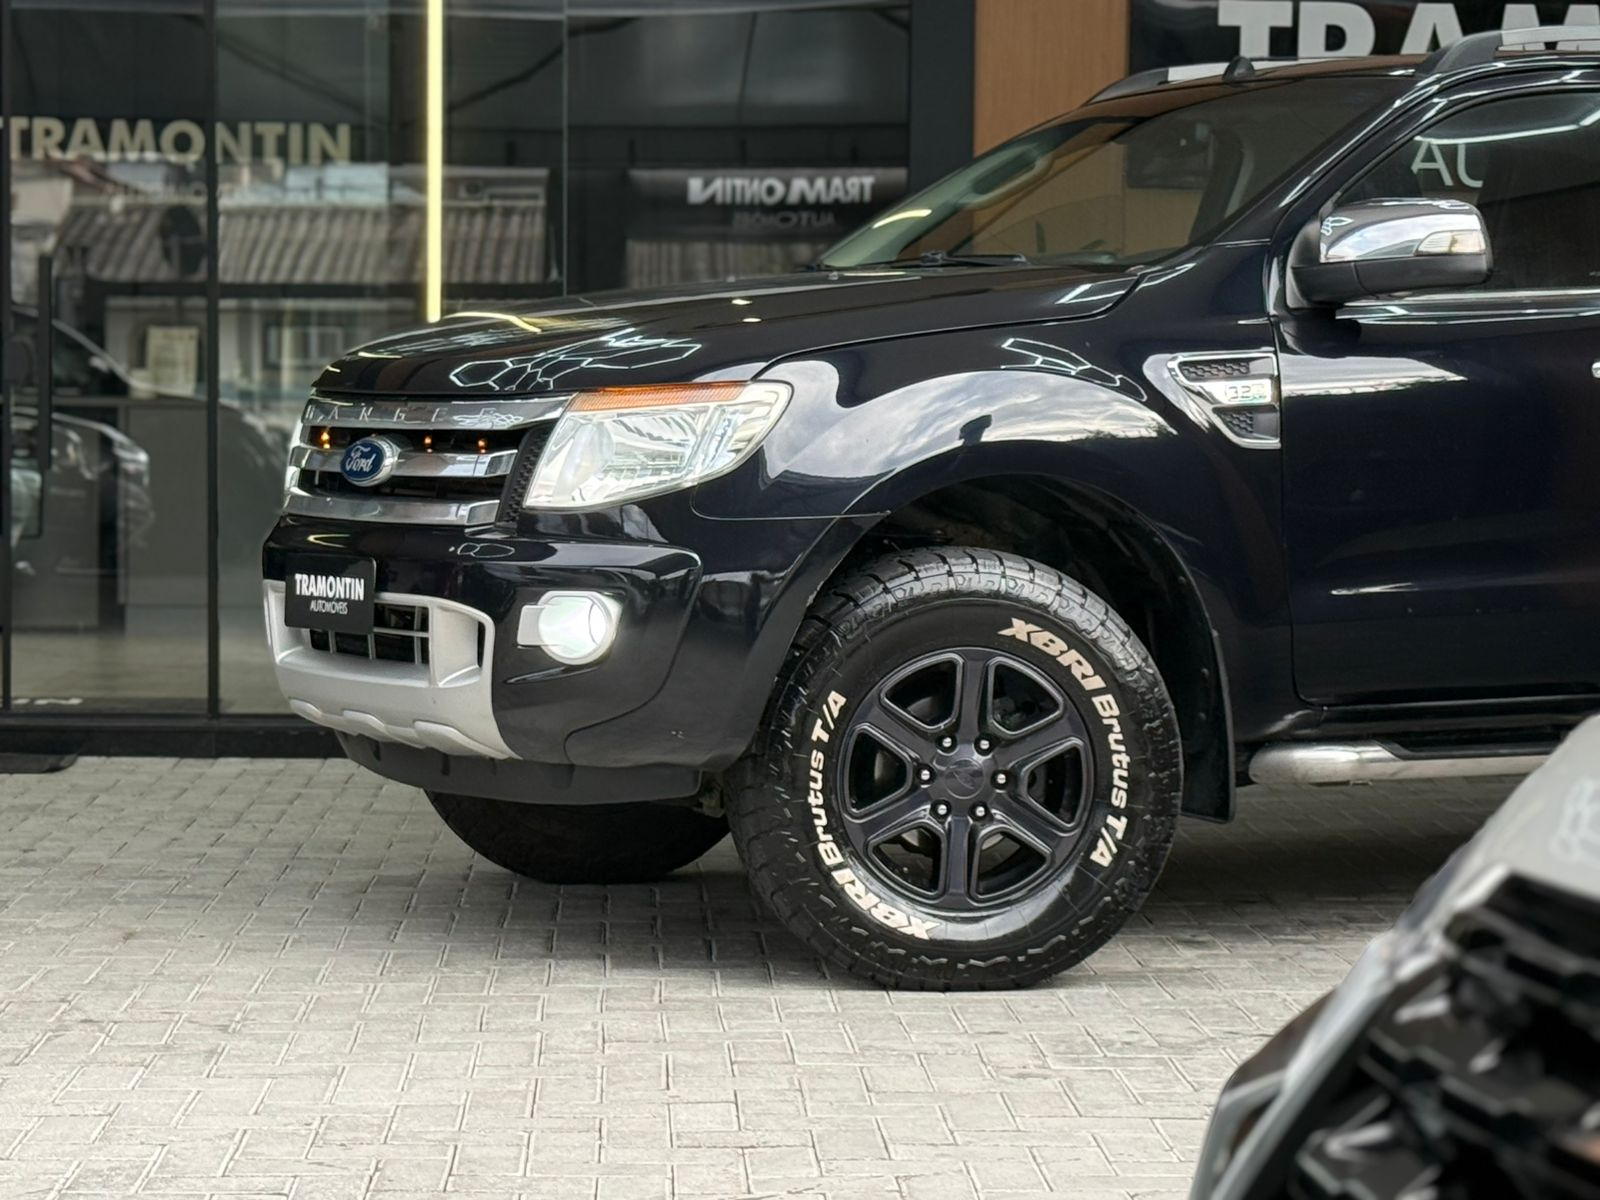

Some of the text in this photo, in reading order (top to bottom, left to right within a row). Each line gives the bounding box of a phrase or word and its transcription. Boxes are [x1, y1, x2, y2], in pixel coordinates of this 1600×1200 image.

[1, 116, 350, 164] TRAMONTIN
[345, 445, 374, 473] Ford
[295, 574, 364, 600] TRAMONTIN
[998, 618, 1131, 868] XBRI Brutus T/A
[808, 690, 942, 940] XBRI Brutus T/A
